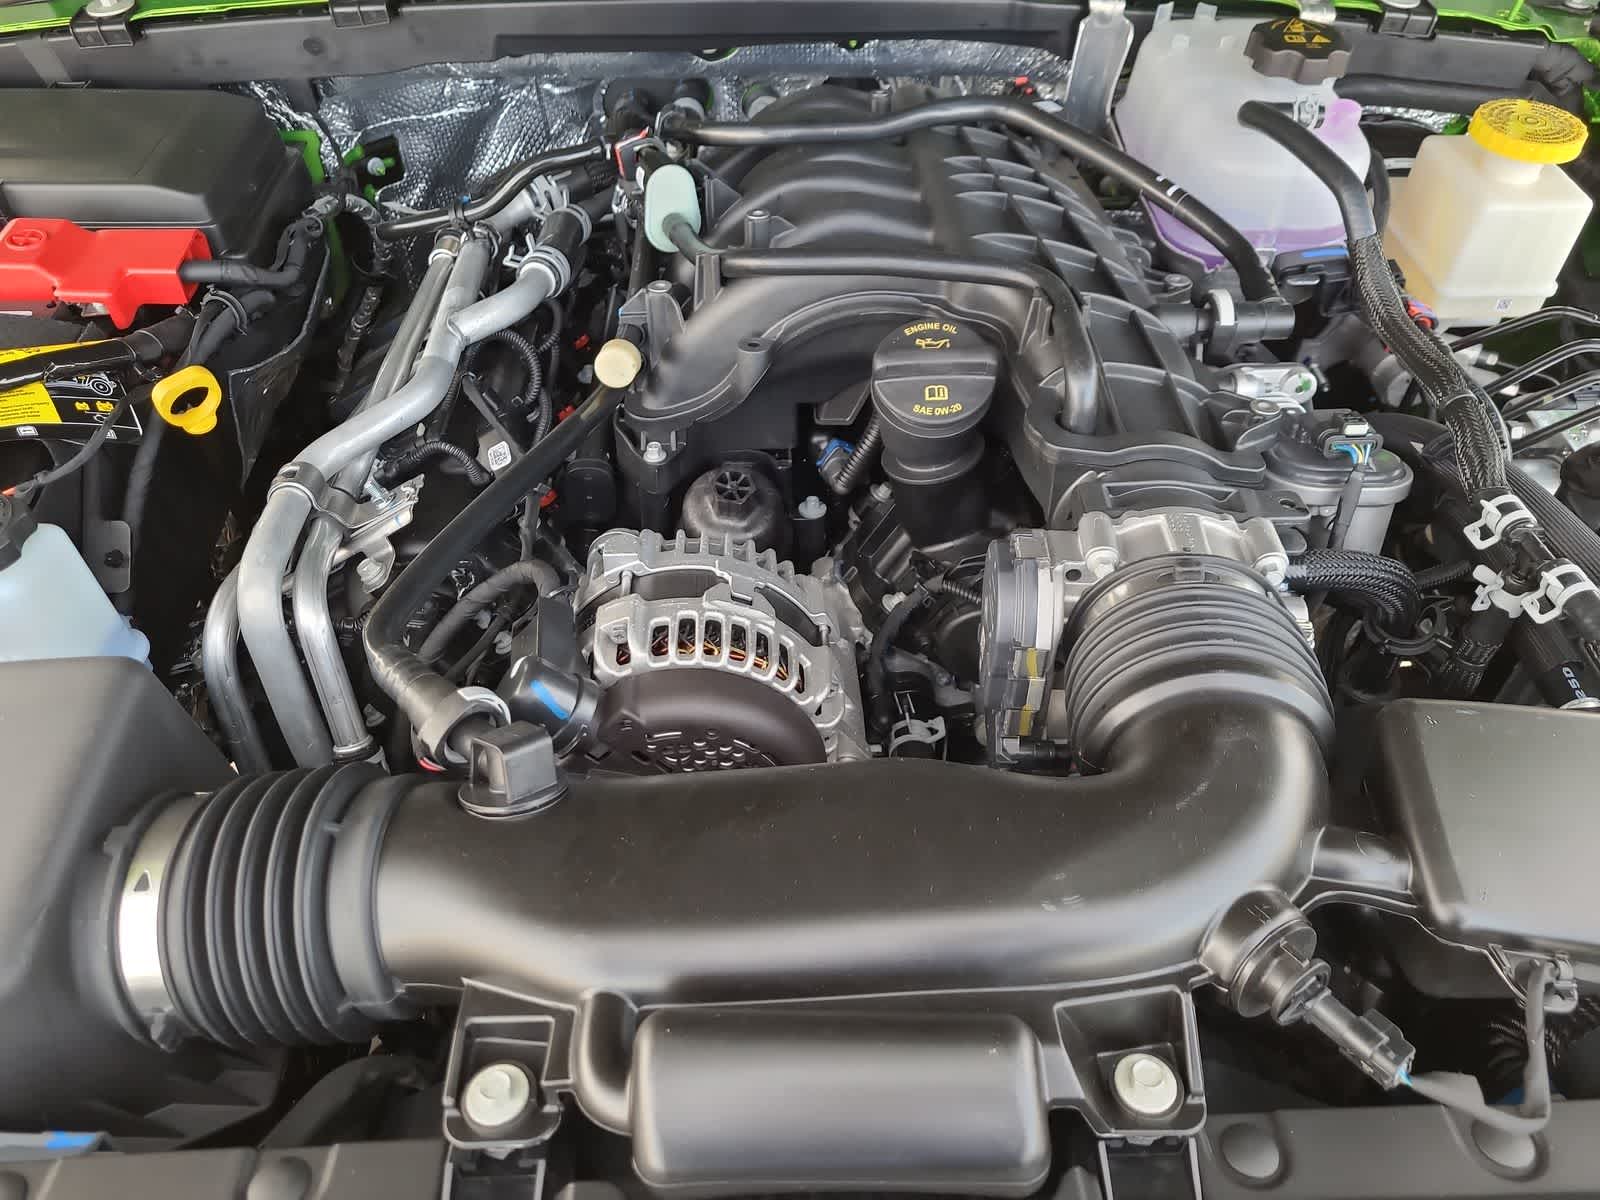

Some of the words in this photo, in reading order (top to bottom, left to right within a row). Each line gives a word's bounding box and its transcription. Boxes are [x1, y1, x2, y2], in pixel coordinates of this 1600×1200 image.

[904, 322, 940, 336] ENGINE
[942, 323, 958, 334] OIL
[913, 404, 933, 415] SAE
[934, 403, 962, 415] 0W-20
